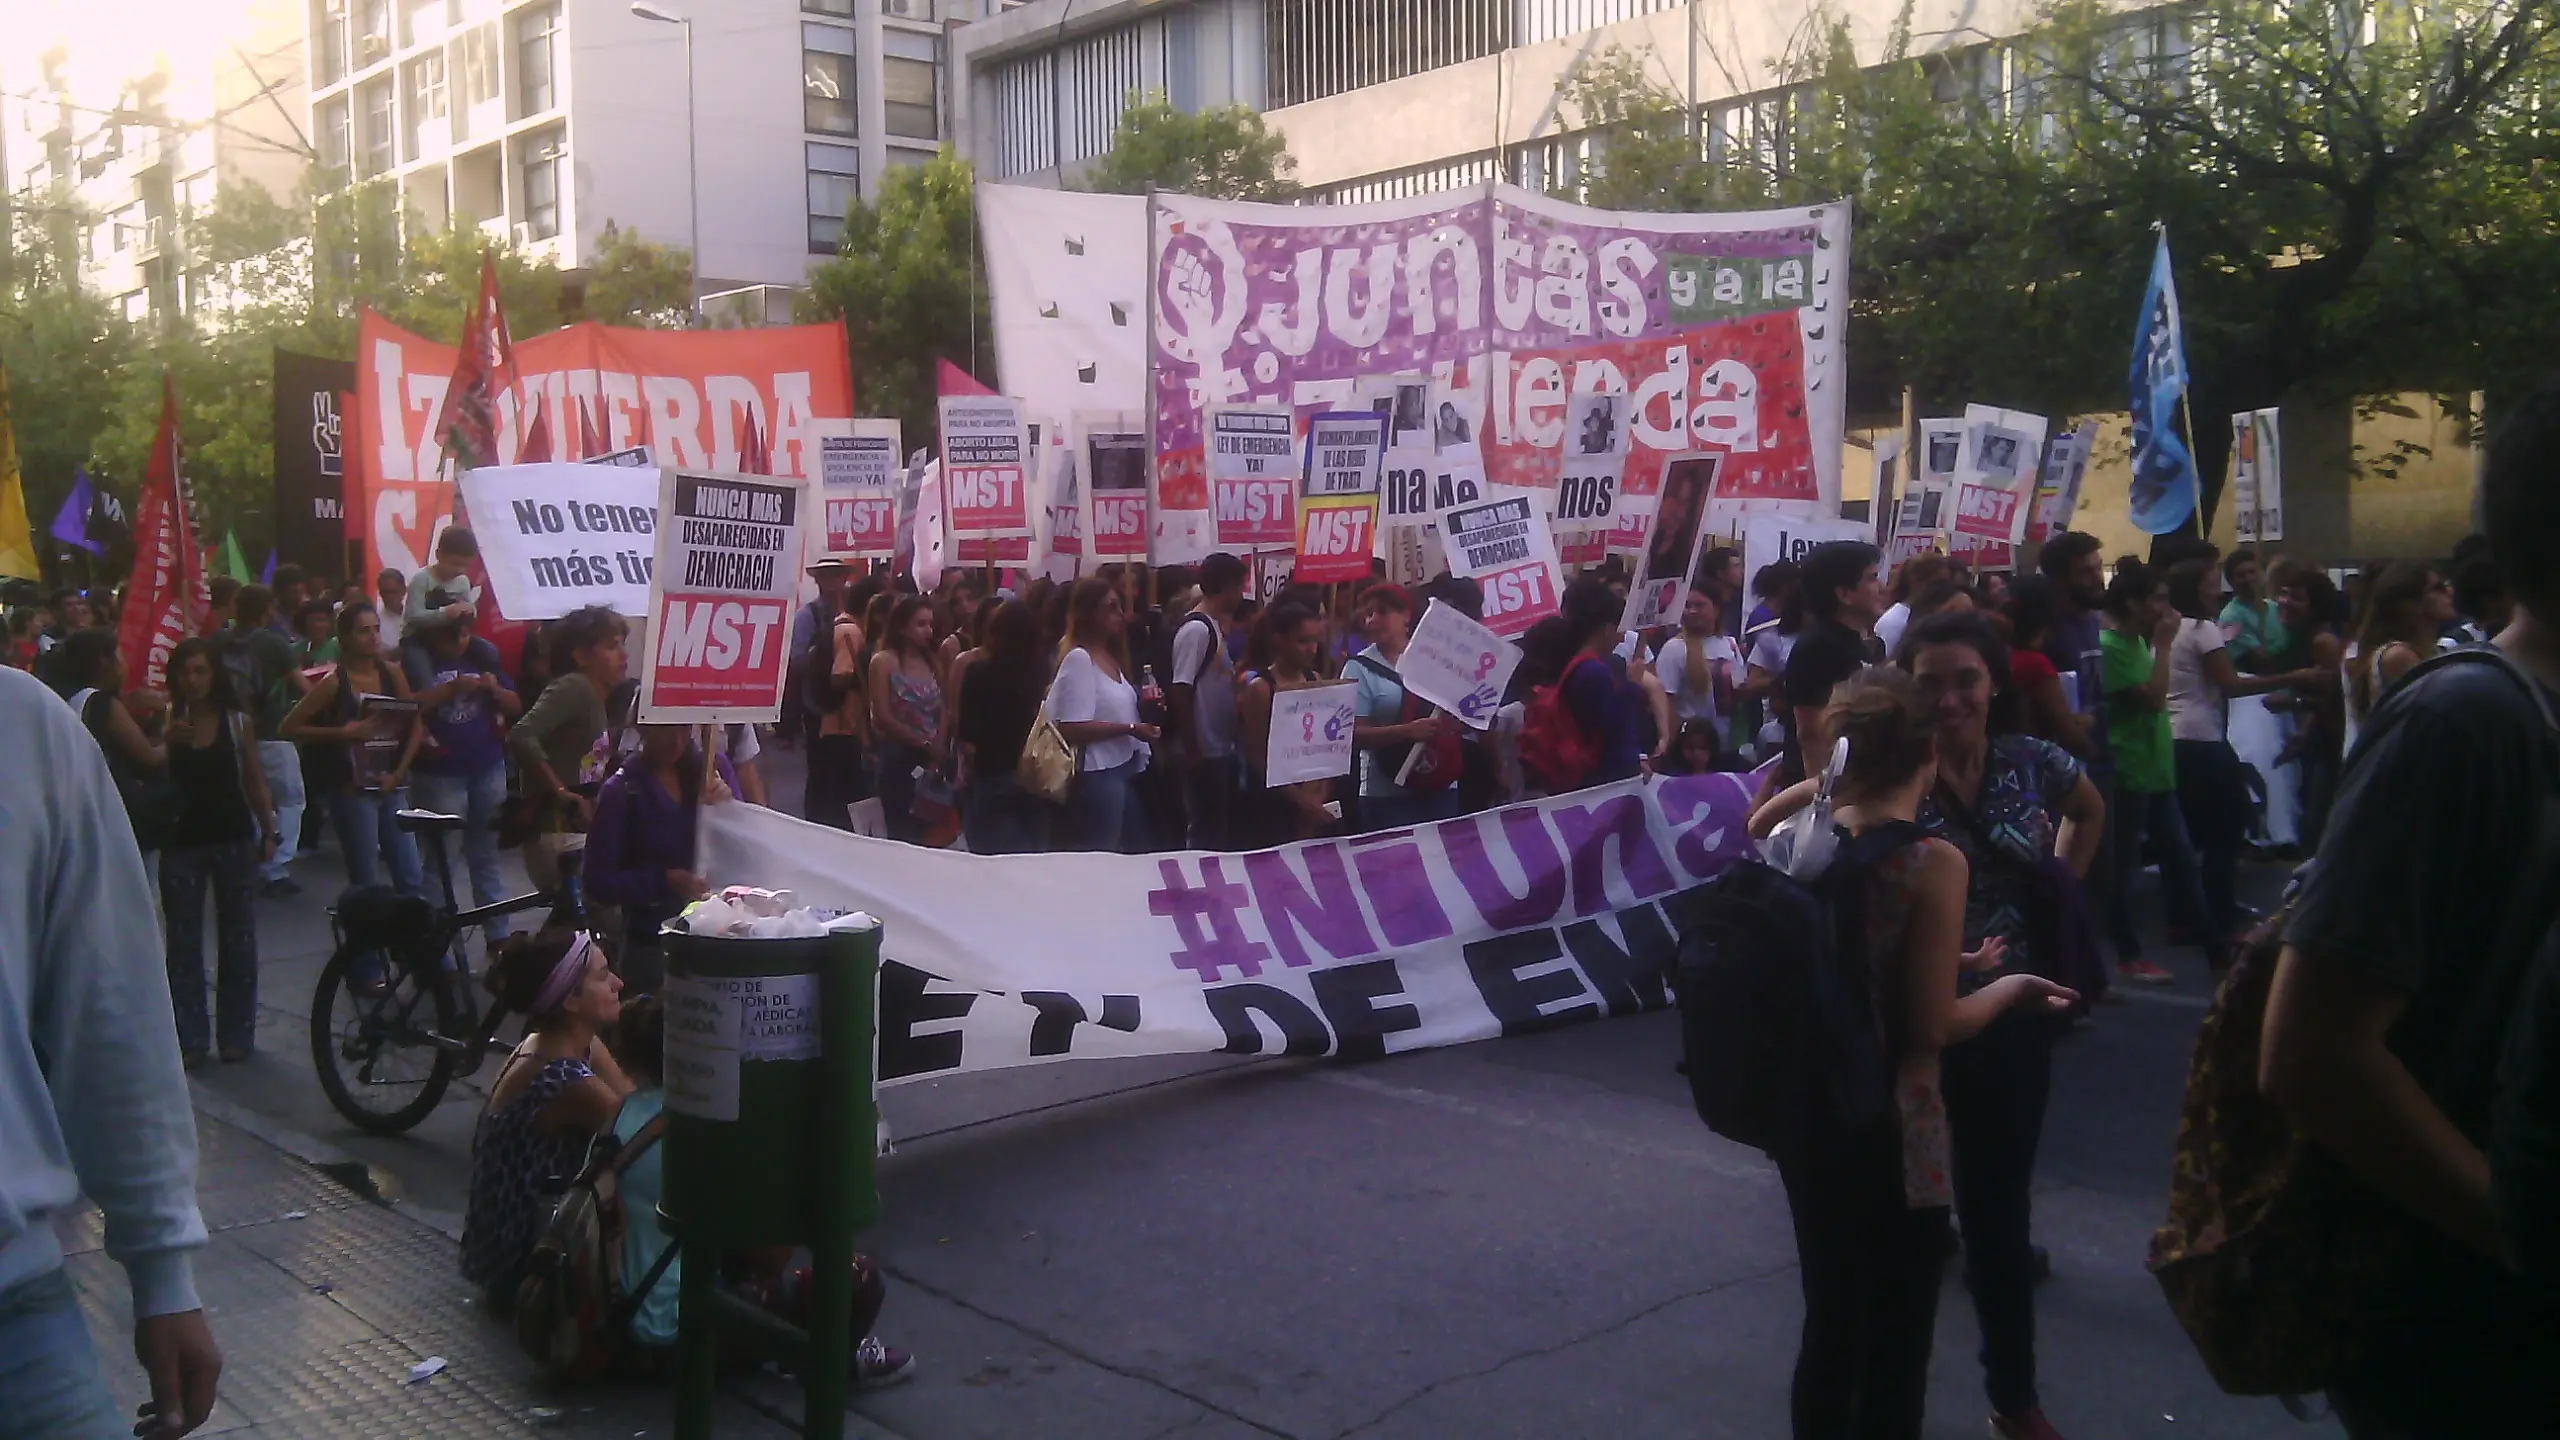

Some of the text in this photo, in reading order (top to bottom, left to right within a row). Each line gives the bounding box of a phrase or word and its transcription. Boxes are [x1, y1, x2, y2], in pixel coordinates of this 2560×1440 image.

[695, 486, 783, 523] NUNCA MAS
[953, 470, 1018, 508] MST
[1217, 482, 1289, 521] MST
[1557, 475, 1614, 519] nos
[1962, 487, 2016, 522] MST
[511, 499, 565, 535] No
[828, 501, 889, 534] MST
[1095, 500, 1147, 535] MS
[1304, 510, 1369, 556] MST
[682, 520, 785, 552] DESAPARECIDAS EN
[1467, 537, 1530, 569] DEMOCRACIA
[530, 548, 614, 588] más
[684, 550, 775, 592] DEMOCRACIA
[658, 600, 781, 670] MST
[772, 993, 790, 1006] DE
